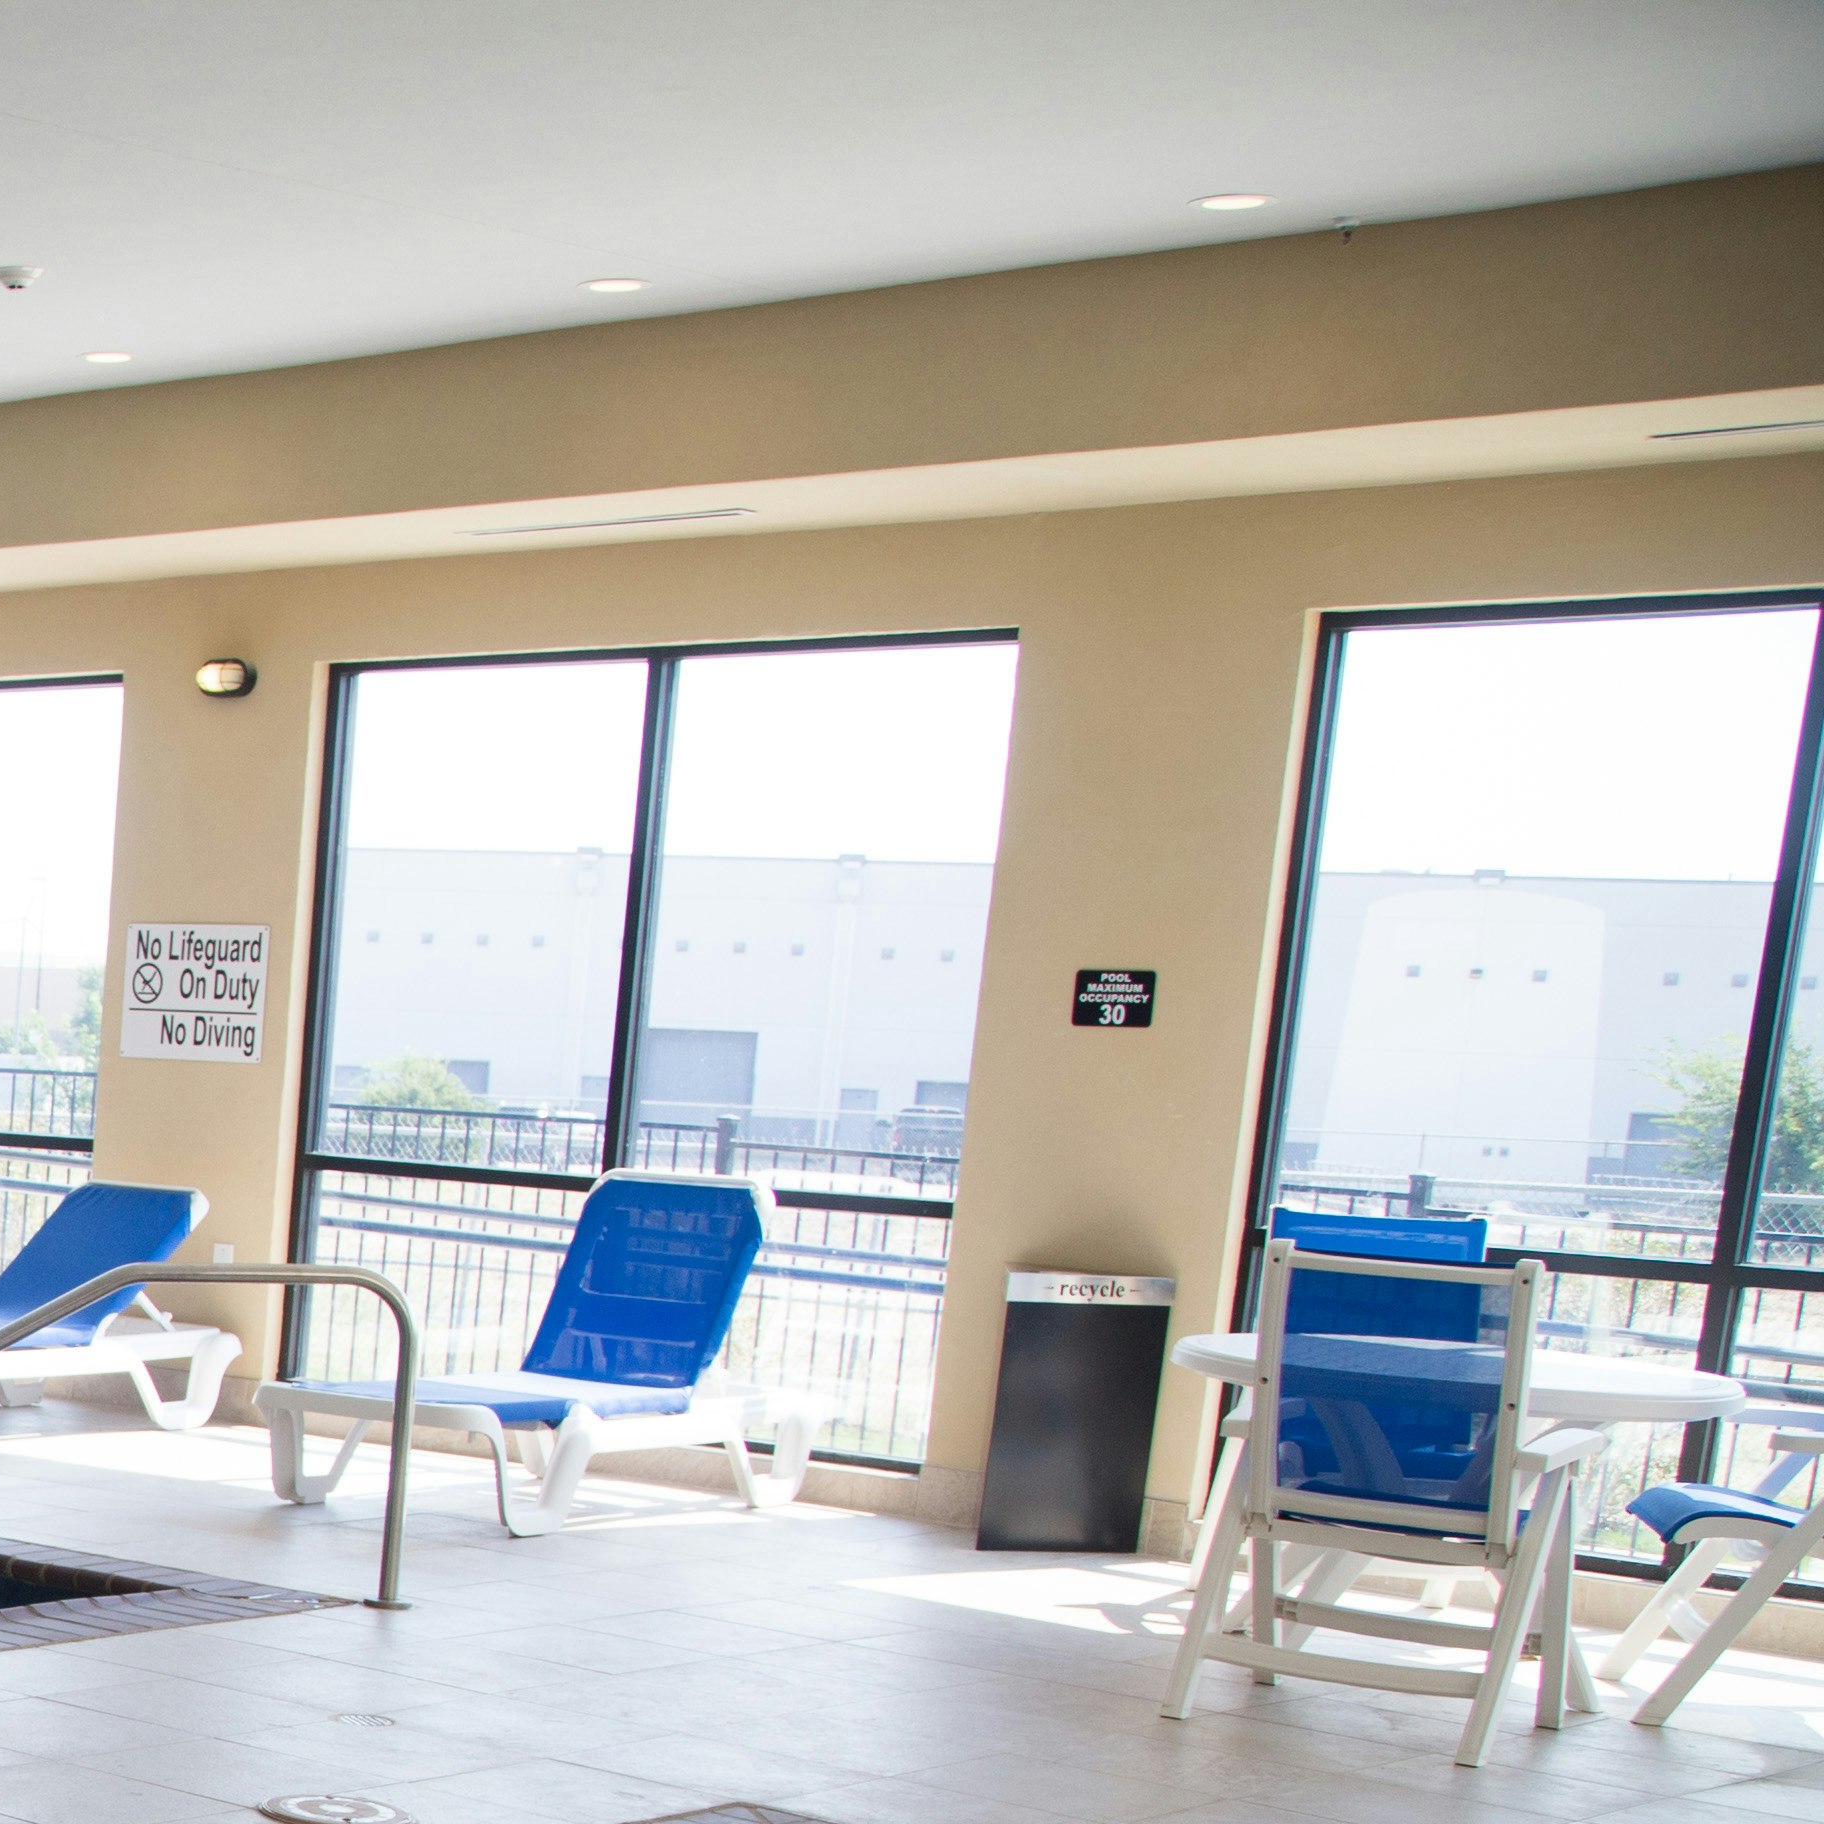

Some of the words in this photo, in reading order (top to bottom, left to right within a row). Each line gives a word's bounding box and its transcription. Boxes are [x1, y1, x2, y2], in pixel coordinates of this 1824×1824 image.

[136, 930, 162, 960] No
[168, 930, 263, 970] Lifeguard
[180, 968, 206, 999] On
[213, 969, 260, 1010] Duty
[1087, 983, 1144, 993] MAXIMUM
[1100, 973, 1131, 983] POOL
[1078, 993, 1150, 1004] OCCUPANCY
[1099, 1003, 1126, 1025] 30
[160, 1014, 186, 1045] No
[193, 1015, 256, 1057] Diving
[1059, 1280, 1126, 1302] recycle
